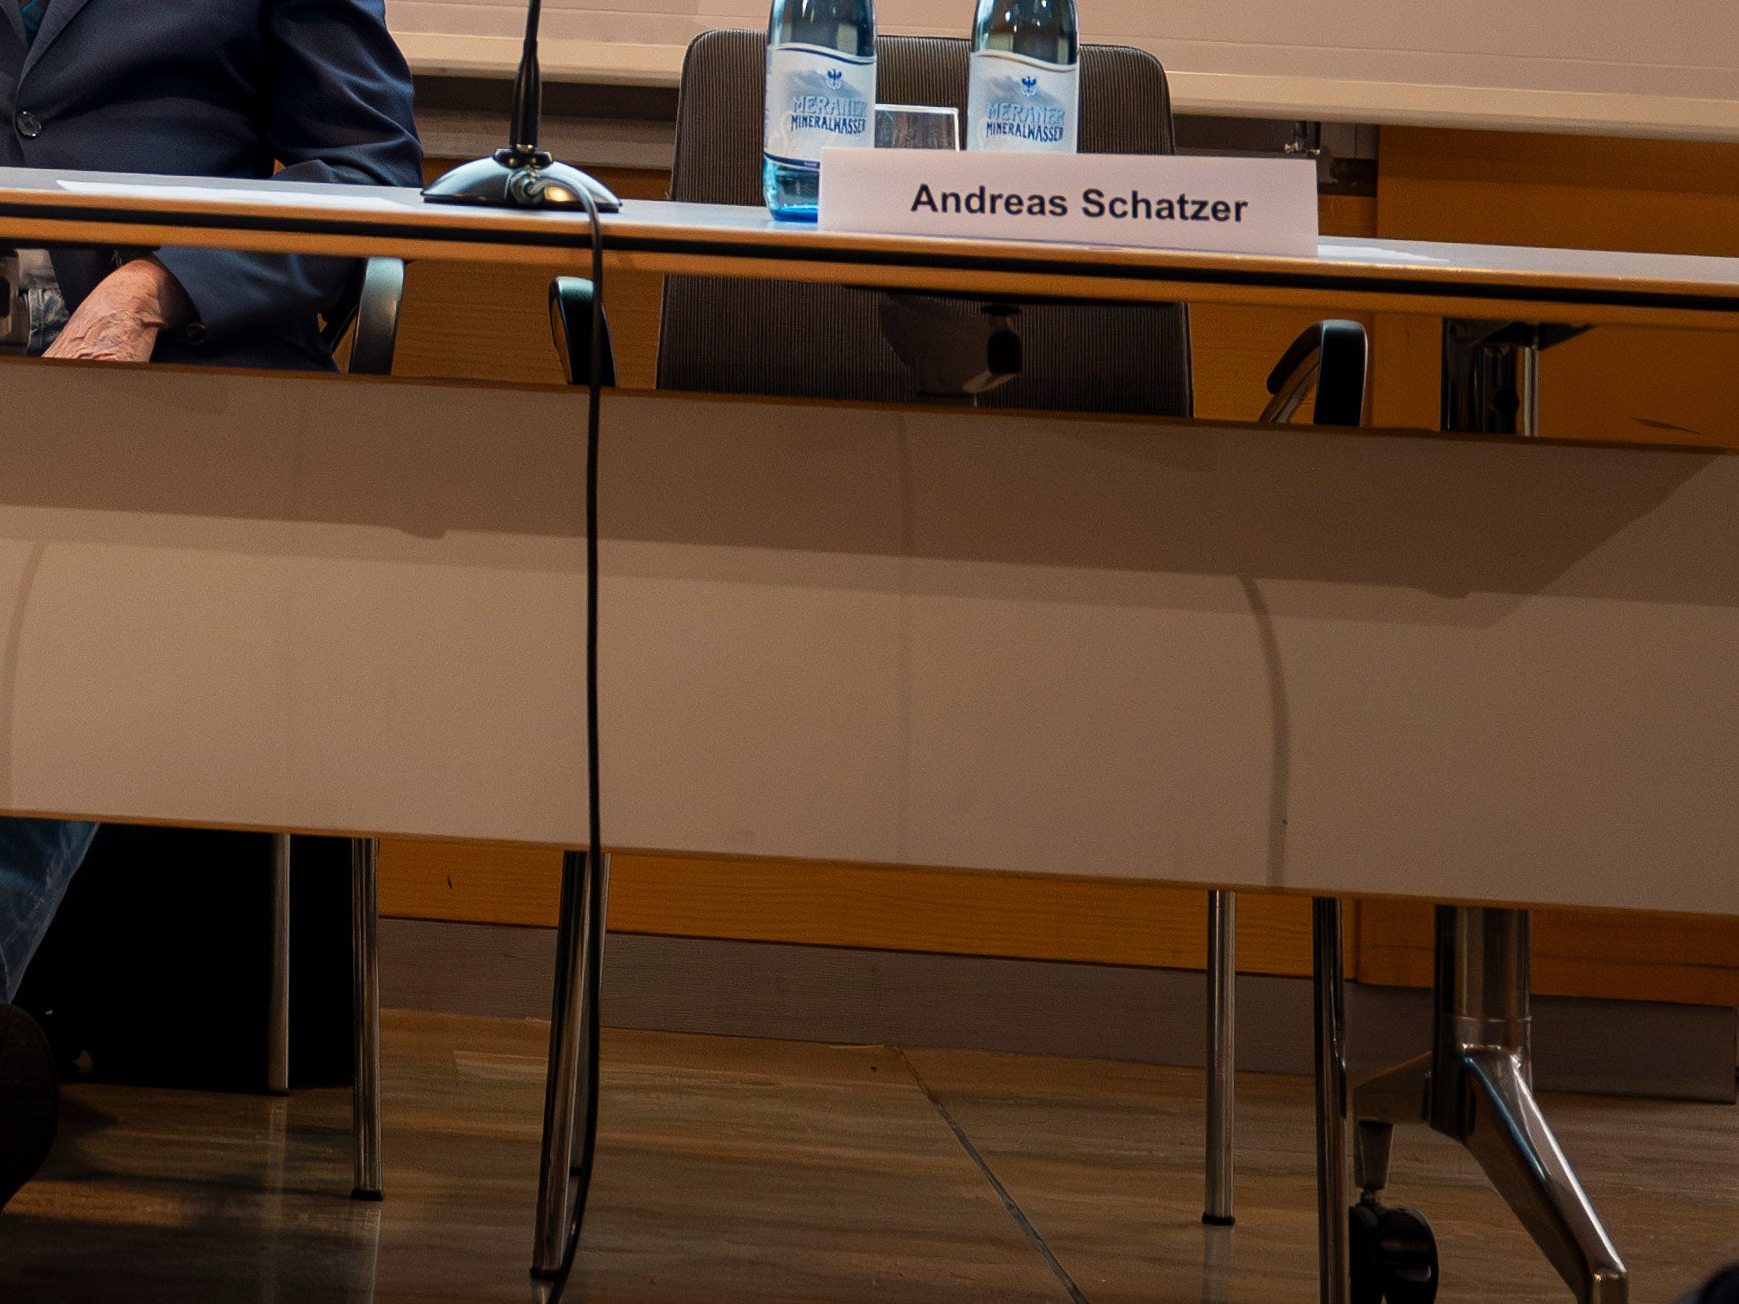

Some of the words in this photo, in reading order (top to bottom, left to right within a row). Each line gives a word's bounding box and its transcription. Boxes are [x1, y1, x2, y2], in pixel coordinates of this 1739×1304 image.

[986, 103, 1065, 126] MERANER
[986, 122, 1064, 142] MINERALWASSER
[911, 184, 1068, 216] Andreas
[1082, 189, 1248, 222] Schatzer
